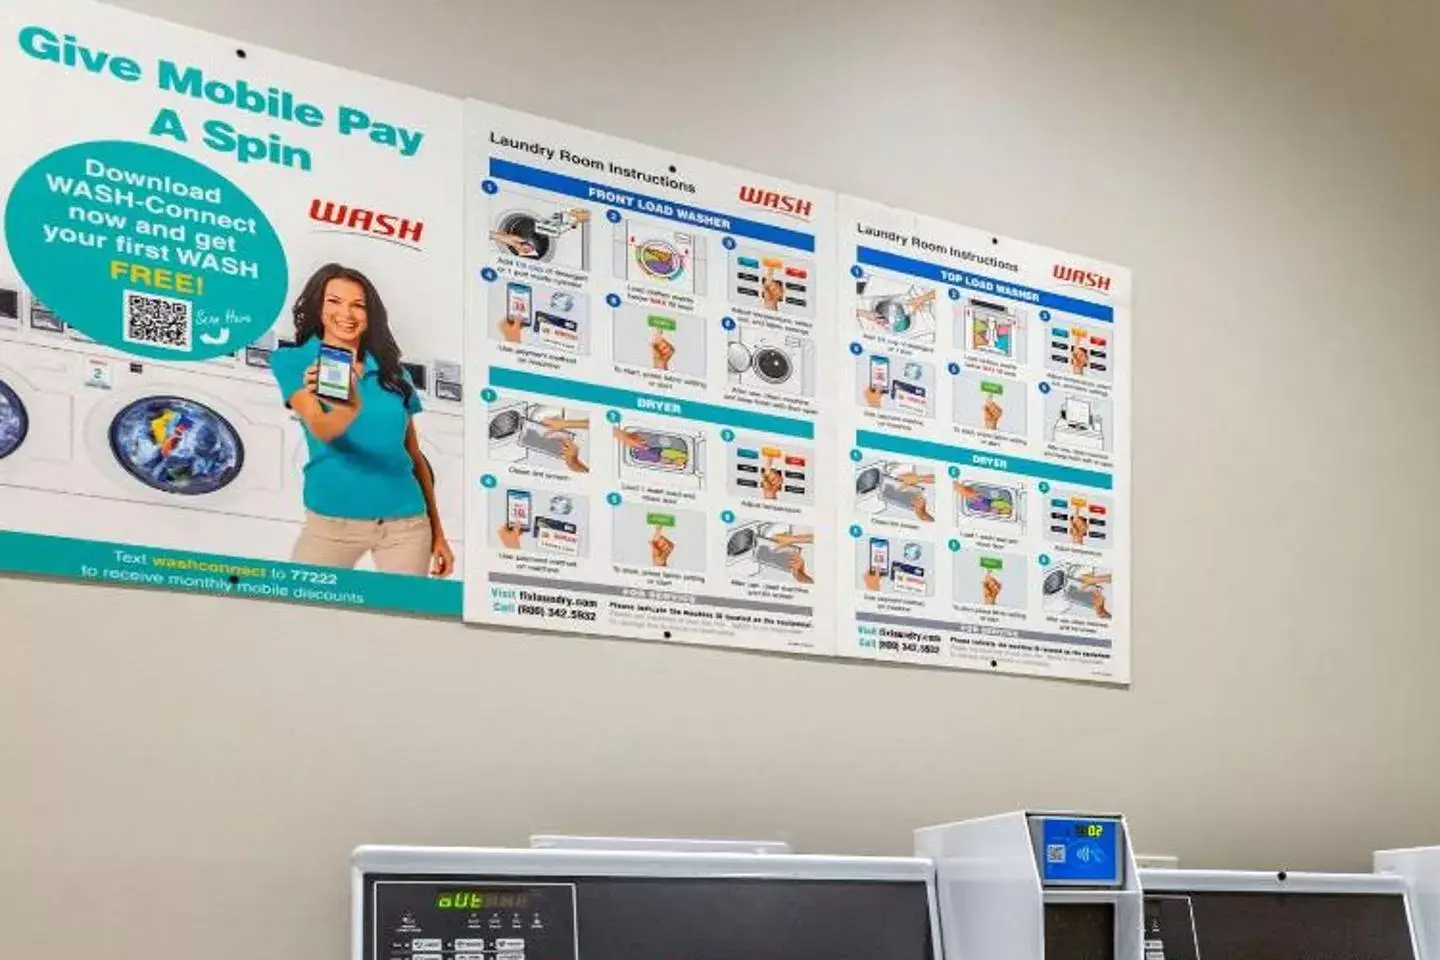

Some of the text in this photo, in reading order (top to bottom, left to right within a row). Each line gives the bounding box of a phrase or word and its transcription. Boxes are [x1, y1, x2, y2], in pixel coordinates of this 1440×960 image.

[18, 25, 425, 157] Give Mobile Pay
[149, 107, 312, 172] A Spin
[489, 131, 697, 195] Laundry Room Instructions
[45, 173, 257, 236] WASH-Connect
[86, 158, 222, 205] Download
[738, 185, 813, 217] WASH
[68, 205, 237, 255] now and get
[308, 198, 426, 244] WASH
[588, 186, 732, 230] FRONT LOAD WASHER
[43, 223, 260, 280] your first WASH
[856, 222, 1018, 272] Laundry Room Instructions
[109, 261, 206, 296] FREE!
[1052, 264, 1111, 291] WASH
[81, 565, 365, 605] to receive monthly mobile discounts
[113, 550, 339, 585] Text washconnect to 77222
